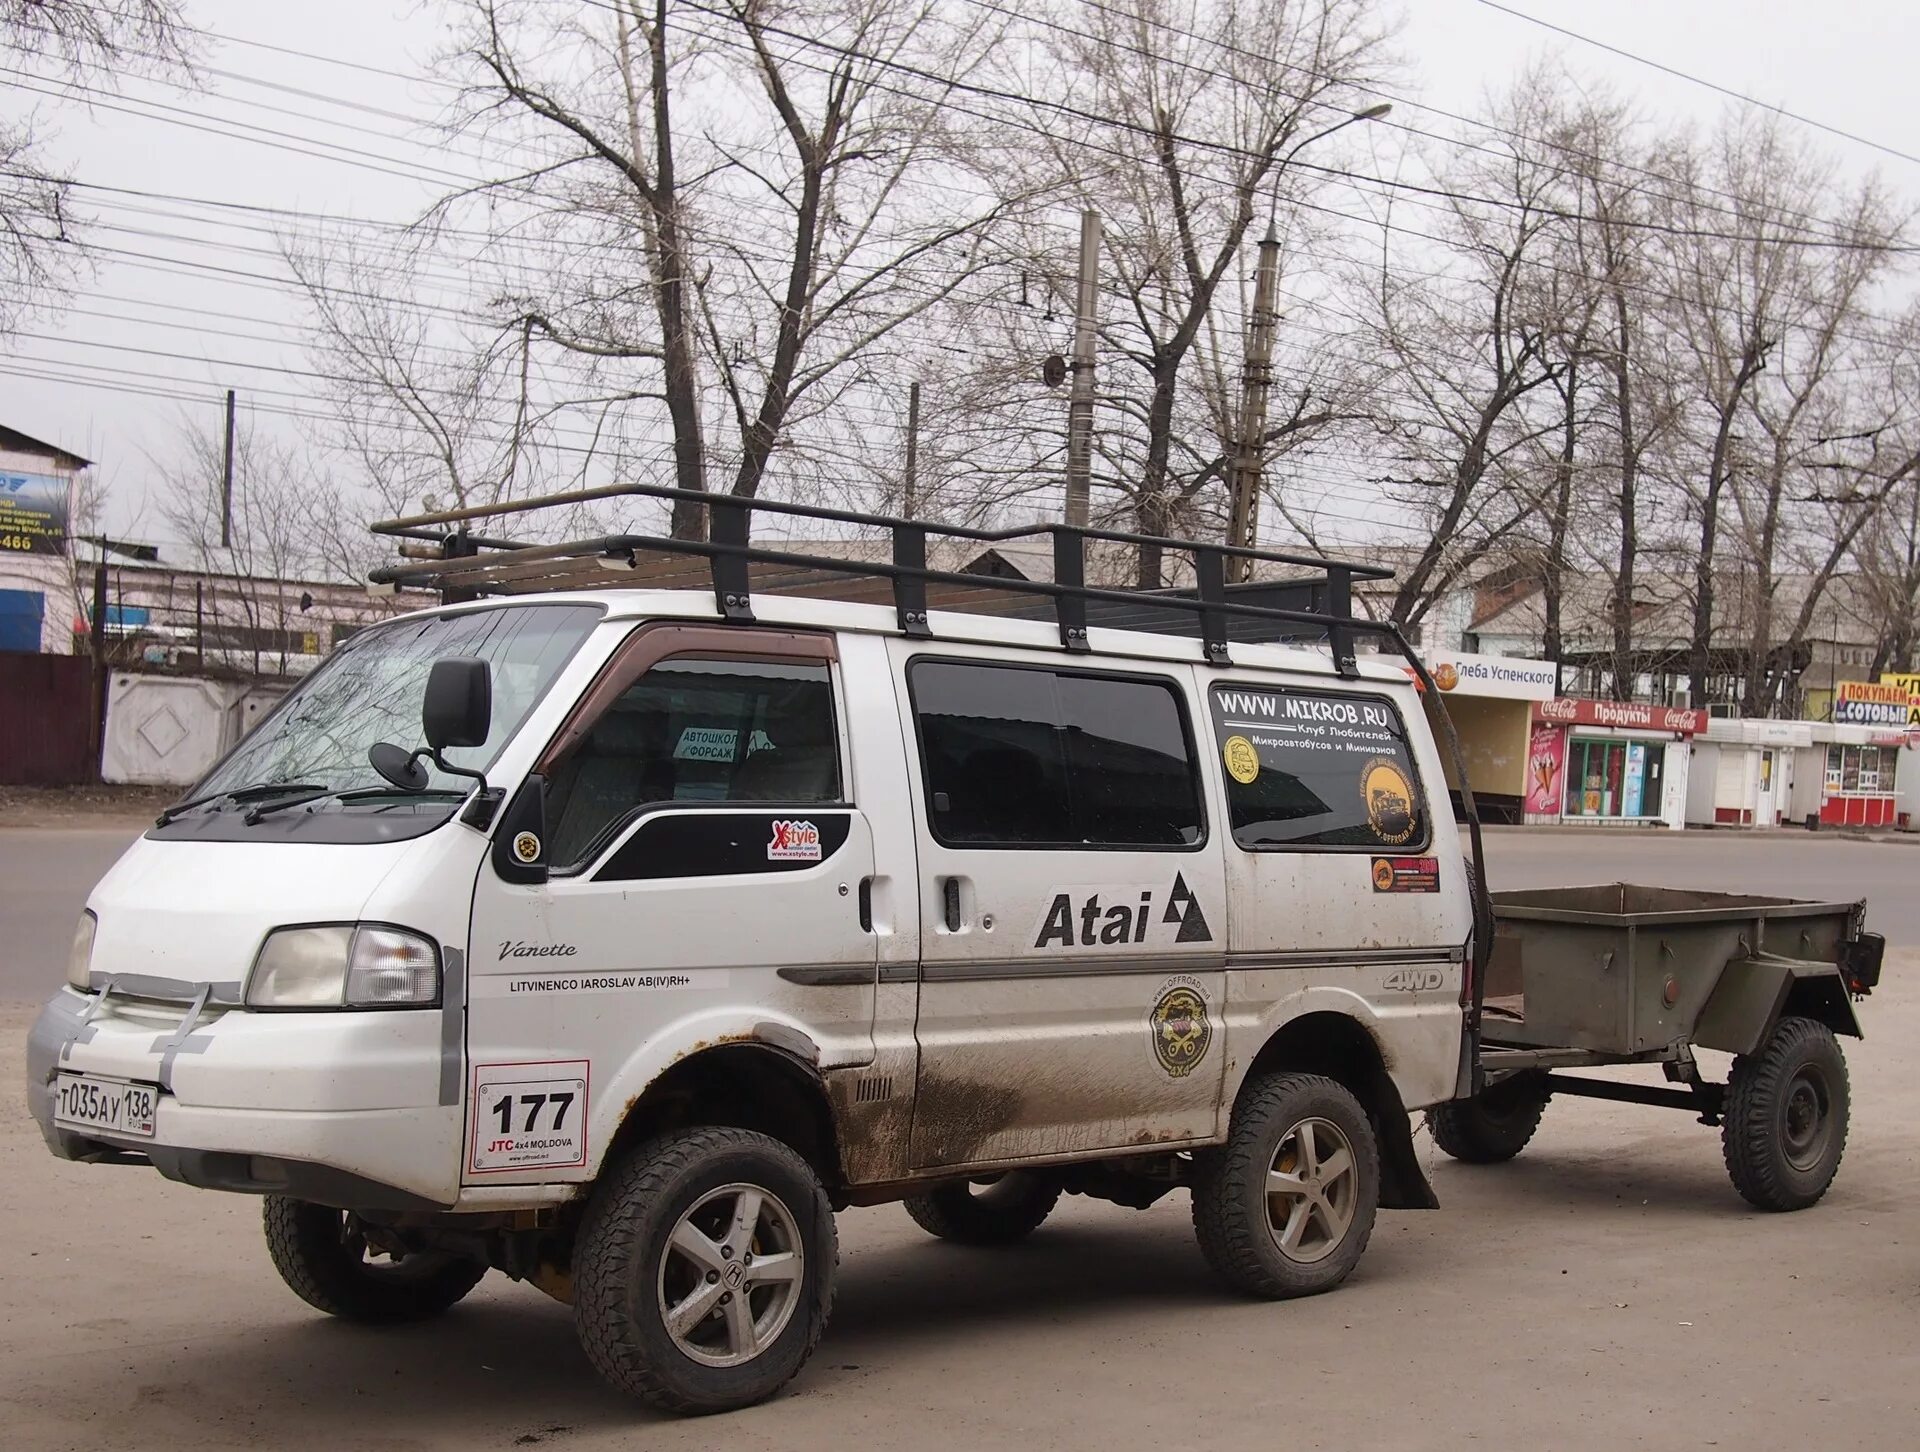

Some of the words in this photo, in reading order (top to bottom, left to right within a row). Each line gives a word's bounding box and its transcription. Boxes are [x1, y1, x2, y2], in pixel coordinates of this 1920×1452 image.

[1491, 666, 1554, 685] Успенского
[1848, 684, 1908, 704] ПОКУПАЕМ
[1594, 703, 1651, 725] Продукты
[1846, 701, 1906, 723] СОТОВЫЕ
[1297, 723, 1325, 737] Клуб
[1329, 726, 1393, 741] Любителей
[1252, 735, 1332, 750] Микроавтобусов
[1335, 743, 1342, 751] и
[1034, 891, 1152, 948] Atai
[498, 940, 578, 961] Vanette
[510, 979, 578, 993] LITVINENCO
[581, 976, 636, 990] IAROSLAV
[637, 975, 691, 989] AB(IV)RH+
[1382, 967, 1444, 992] 4WD
[124, 1090, 150, 1119] 138
[492, 1092, 575, 1134] 177
[127, 1117, 142, 1129] RUS
[487, 1139, 514, 1153] JTC
[514, 1139, 530, 1150] 4x4
[530, 1137, 573, 1150] MOLDOVA
